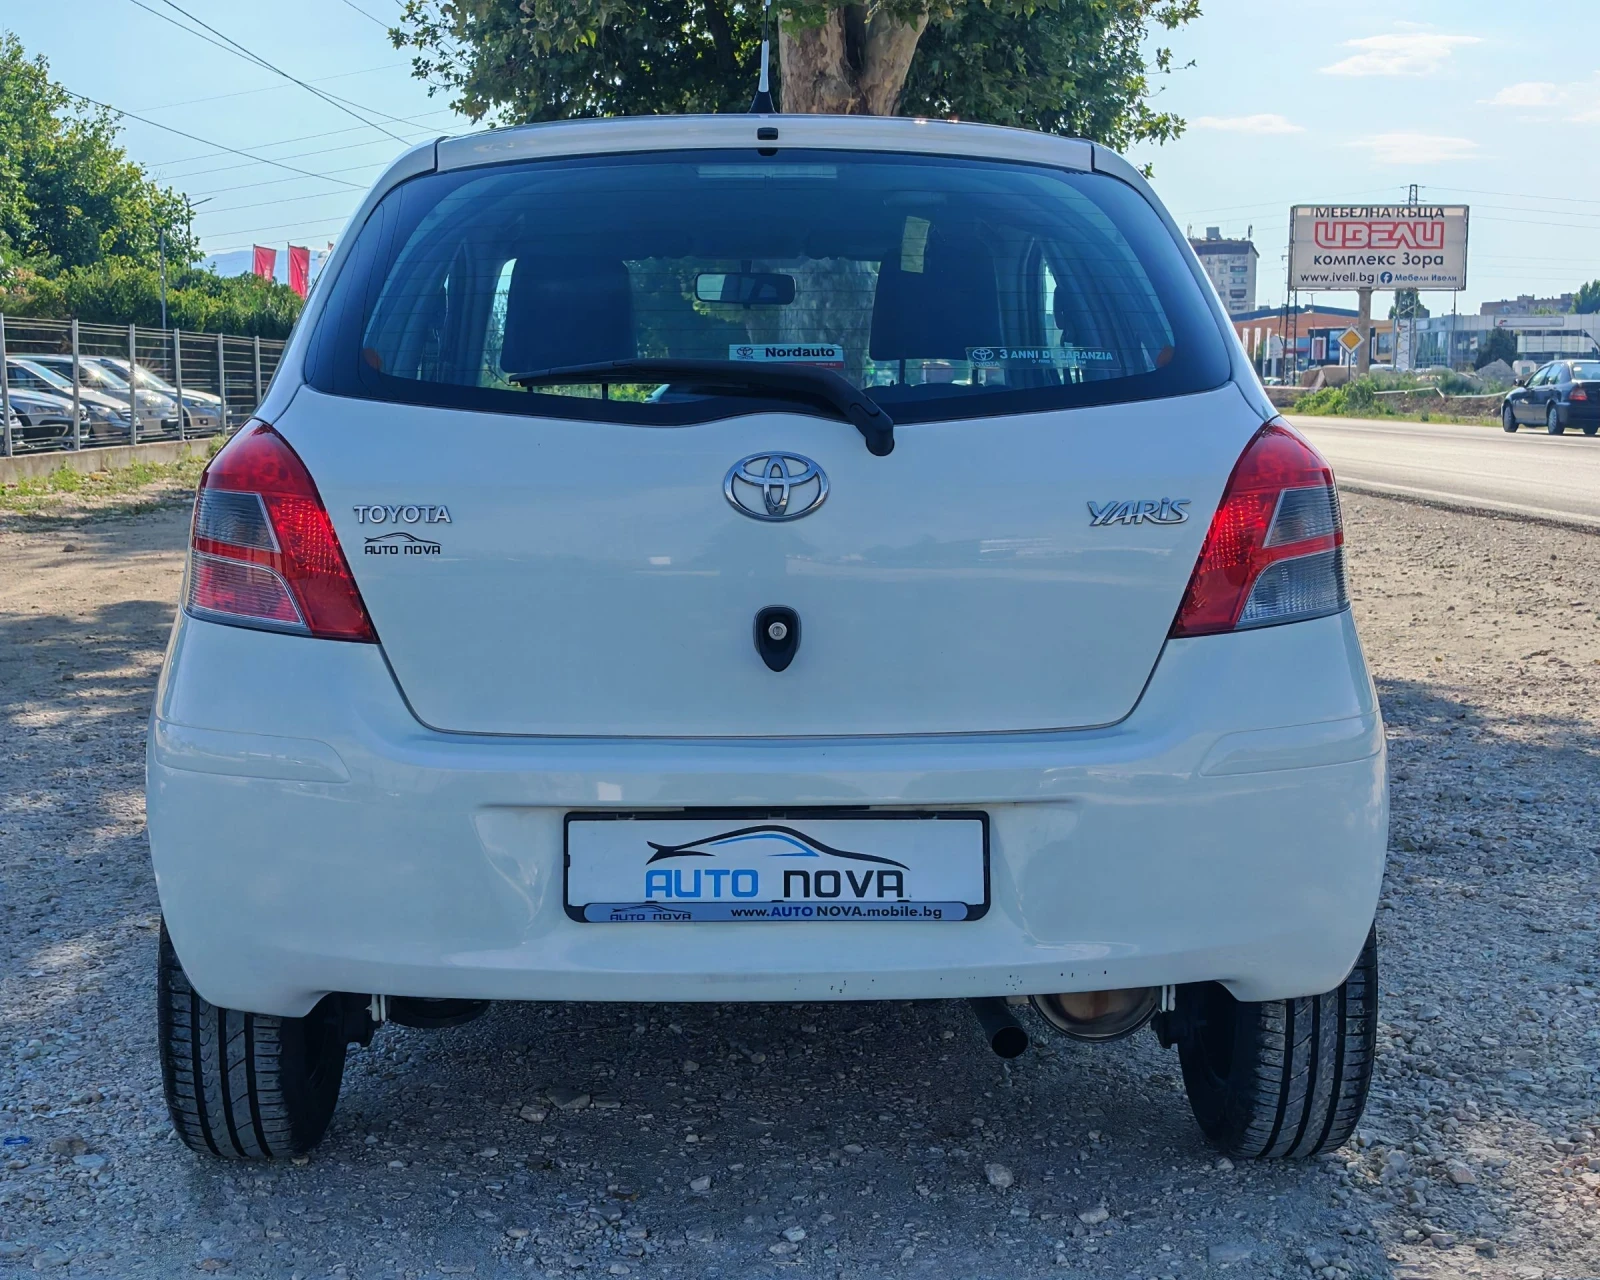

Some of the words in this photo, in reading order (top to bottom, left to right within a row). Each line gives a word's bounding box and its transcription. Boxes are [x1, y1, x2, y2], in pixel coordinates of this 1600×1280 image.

[1315, 207, 1391, 218] МЕБЕЛНА
[1396, 207, 1445, 220] КЪЩА
[1314, 254, 1396, 266] комплекс
[1402, 252, 1444, 268] Зора
[1300, 272, 1375, 284] www.iveli.bg
[765, 347, 835, 357] Nordauto
[999, 349, 1008, 359] 3
[1011, 351, 1039, 359] ANNI
[353, 505, 452, 523] TOYOTA
[365, 545, 398, 555] AUTO
[404, 545, 441, 555] NOVA
[645, 869, 759, 898] AUTO
[783, 870, 904, 898] NOVA
[610, 913, 646, 921] AUTO
